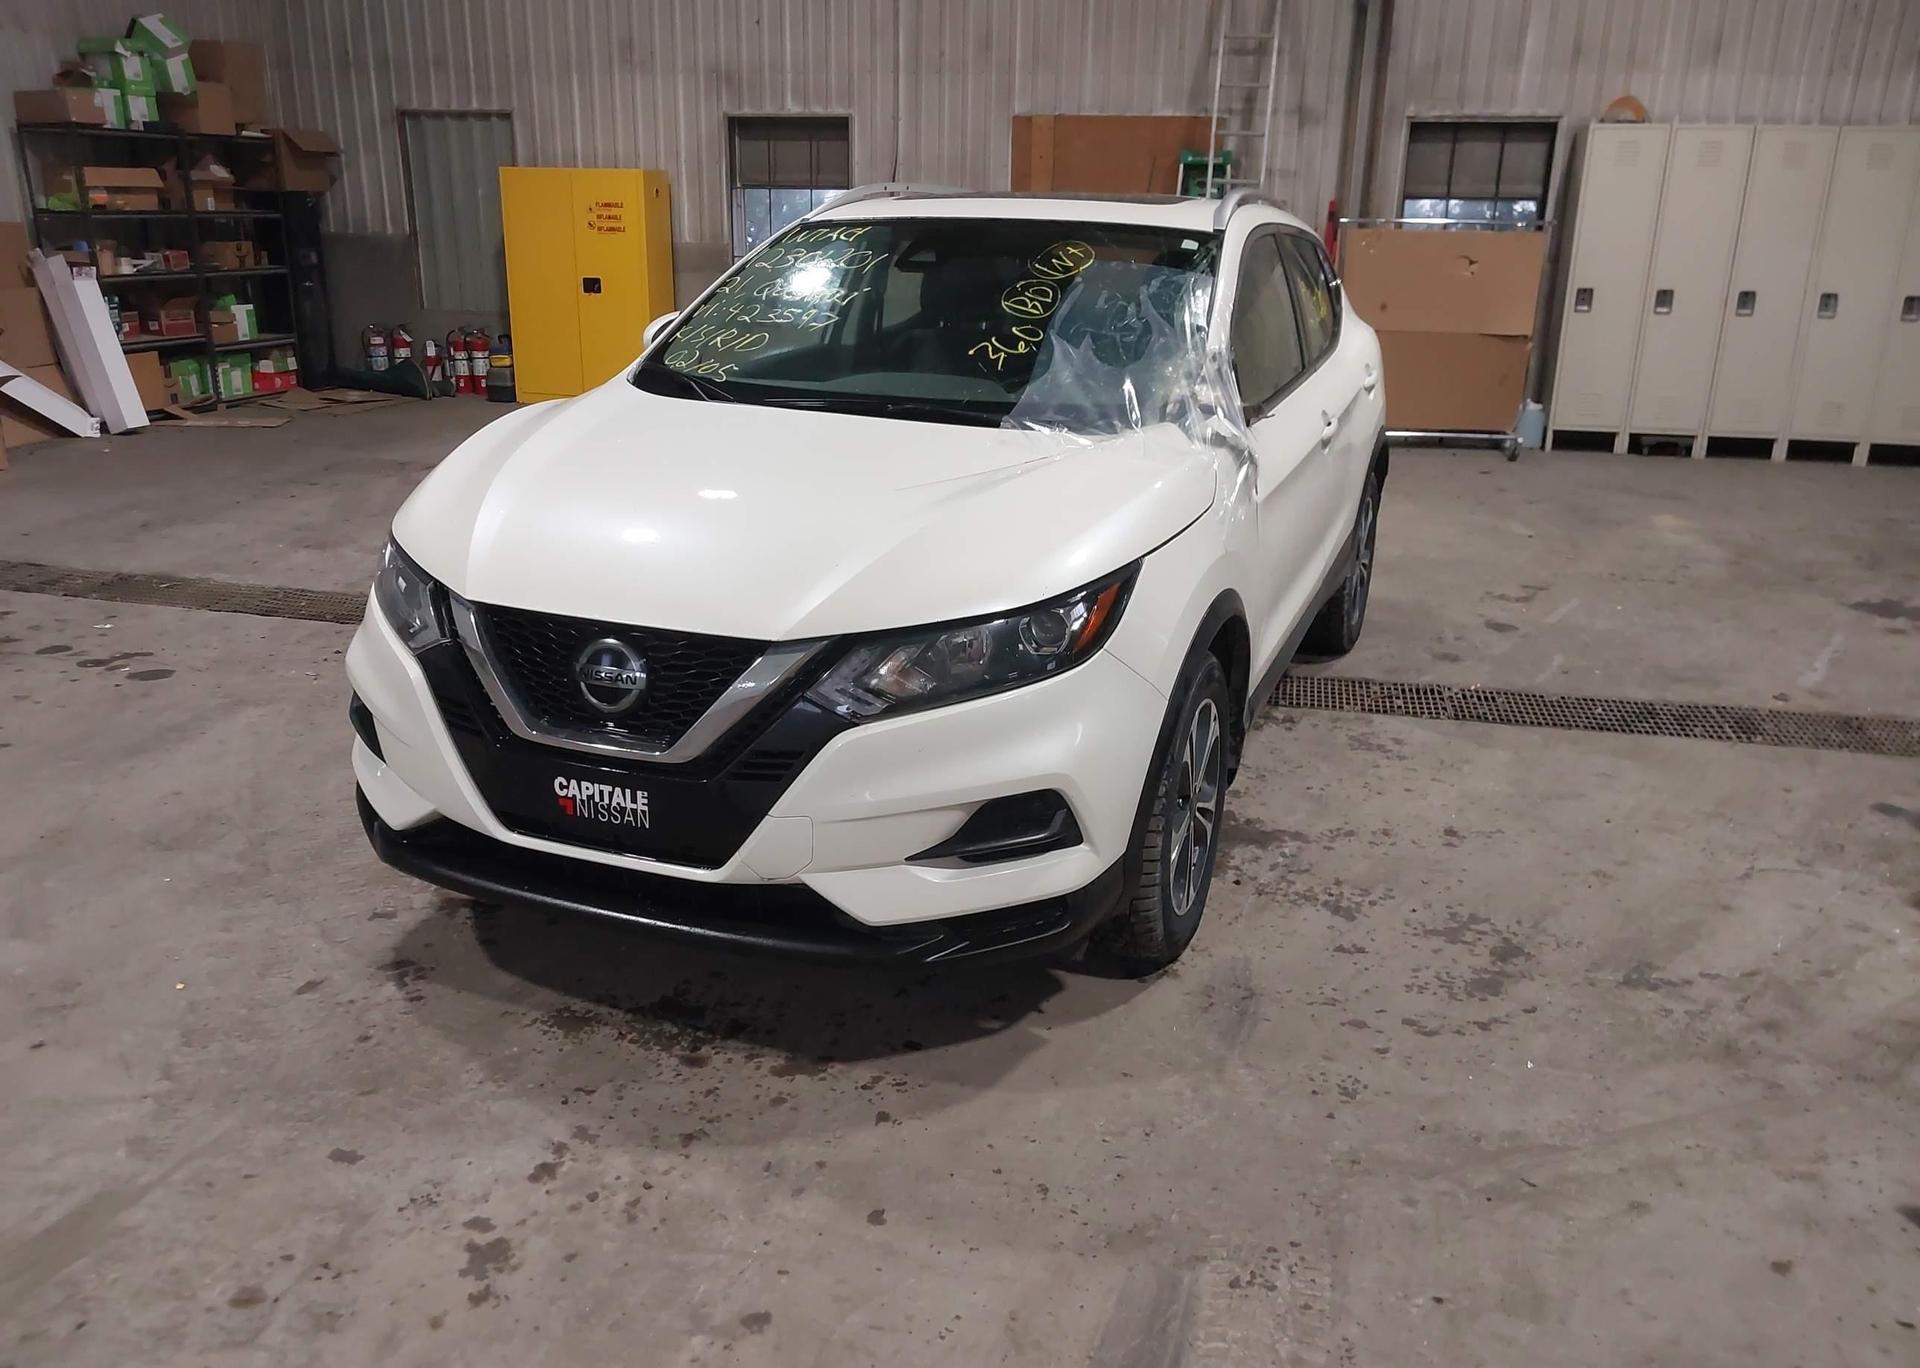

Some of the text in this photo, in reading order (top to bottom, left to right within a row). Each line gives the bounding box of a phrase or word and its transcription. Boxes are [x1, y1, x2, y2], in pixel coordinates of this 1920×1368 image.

[580, 667, 638, 686] NISSAN
[553, 775, 649, 812] CAPITALE
[575, 798, 650, 830] NISSAN
